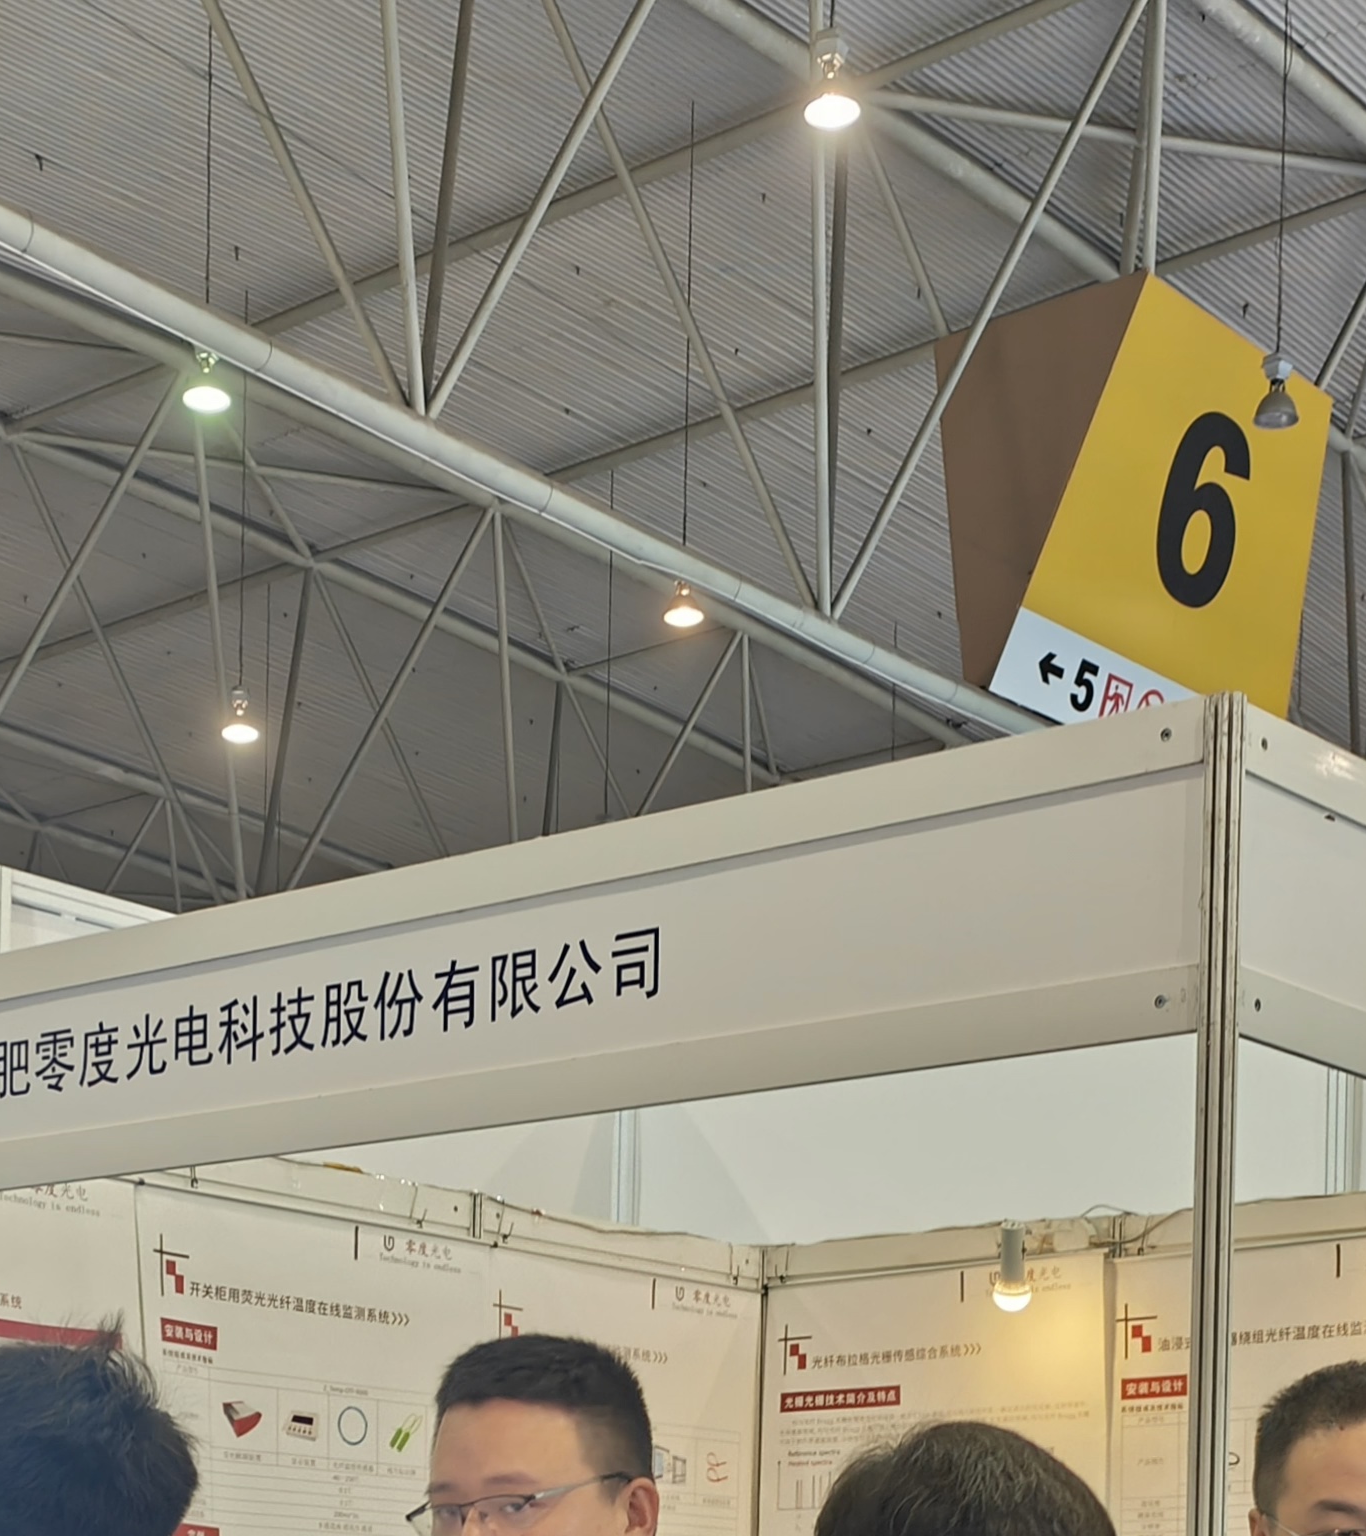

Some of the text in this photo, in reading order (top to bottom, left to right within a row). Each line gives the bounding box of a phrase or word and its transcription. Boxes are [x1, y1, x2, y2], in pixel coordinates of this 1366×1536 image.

[1156, 411, 1250, 608] 6
[1069, 659, 1100, 712] 5
[189, 1281, 390, 1324] 开关柜用荧光光纤温度在线监测系统
[811, 1344, 963, 1370] 光纤布拉格光栅传感综合系统
[1125, 1380, 1184, 1396] 安装与设计
